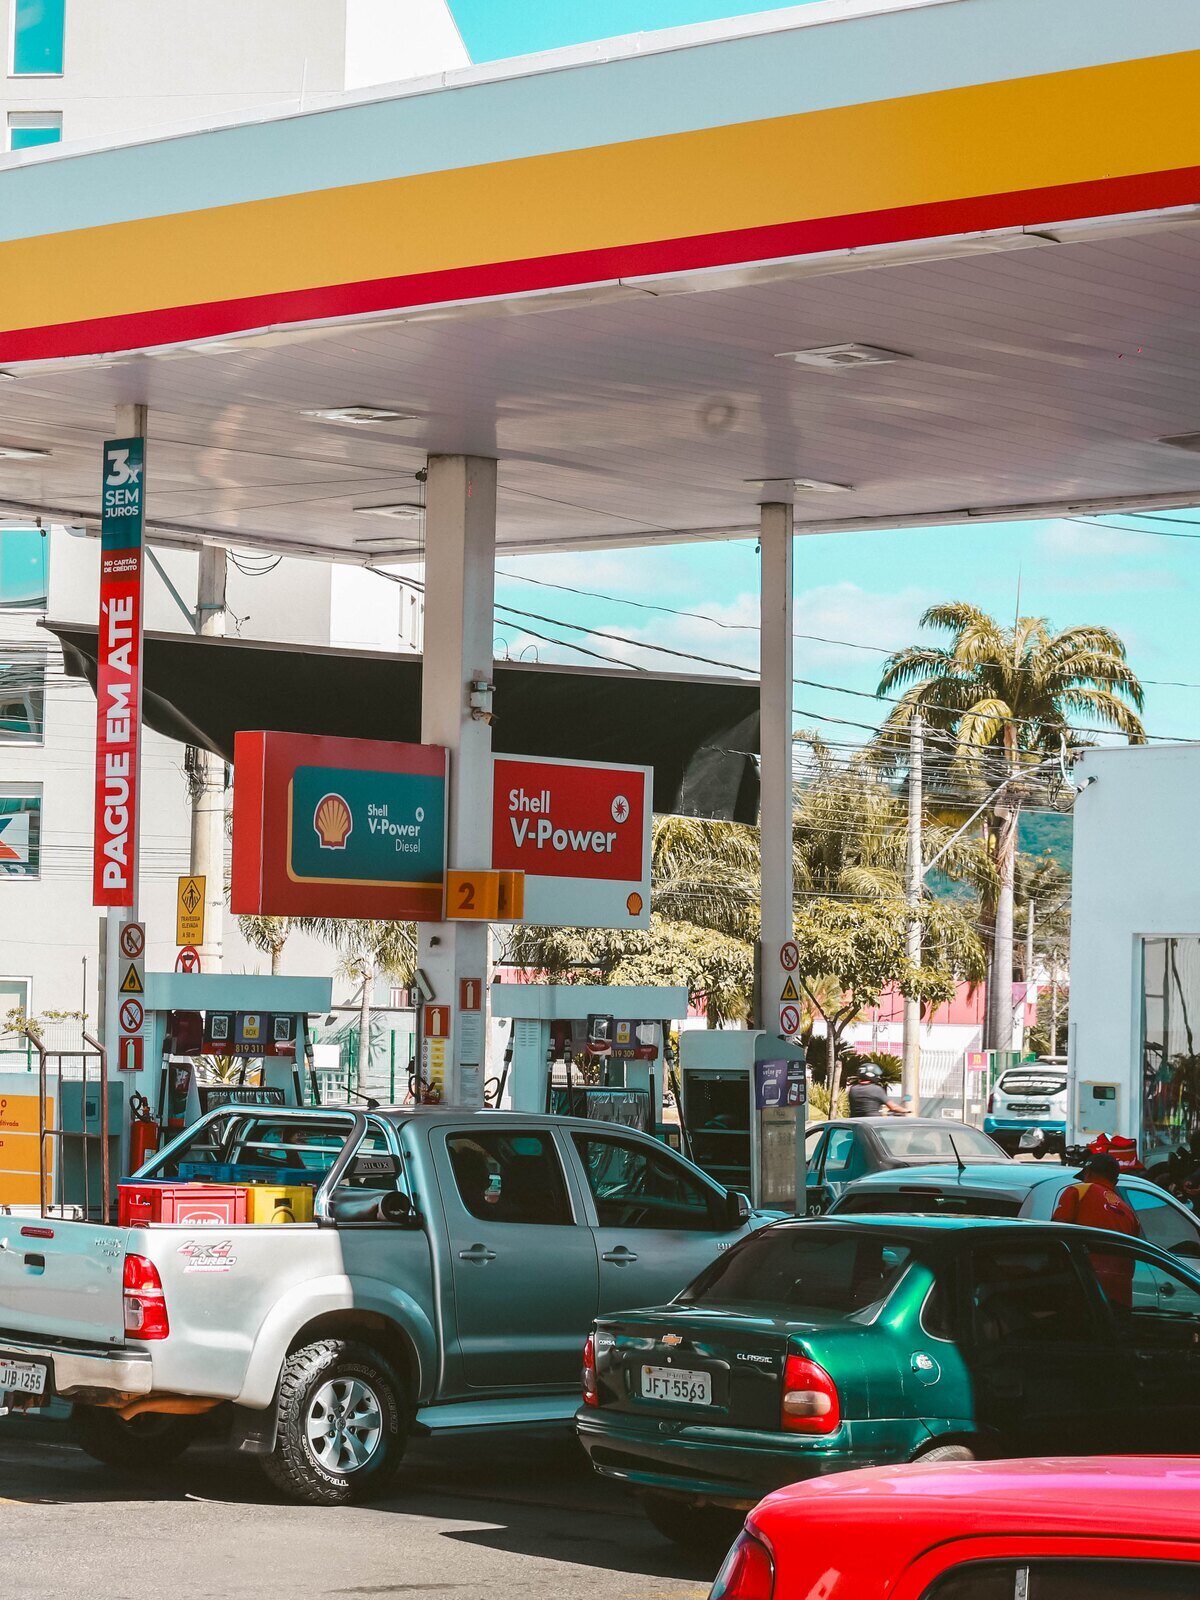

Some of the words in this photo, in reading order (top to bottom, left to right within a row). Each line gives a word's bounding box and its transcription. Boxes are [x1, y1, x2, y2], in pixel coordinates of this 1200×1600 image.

[105, 488, 139, 506] SEM
[105, 506, 139, 518] JUROS
[114, 557, 137, 567] CARTÃO
[102, 596, 133, 675] ATÉ
[106, 683, 131, 743] EM
[508, 788, 551, 814] Shell
[367, 804, 388, 817] Shell
[103, 751, 130, 890] PAGUE
[367, 817, 421, 837] V-Power
[509, 816, 617, 854] V-Power
[395, 838, 421, 853] Diesel
[458, 882, 475, 910] 2
[235, 1044, 249, 1053] 819
[250, 1044, 264, 1053] 311
[623, 1049, 635, 1058] 309
[188, 1255, 237, 1267] TURBO
[736, 1353, 773, 1364] CLASSIC
